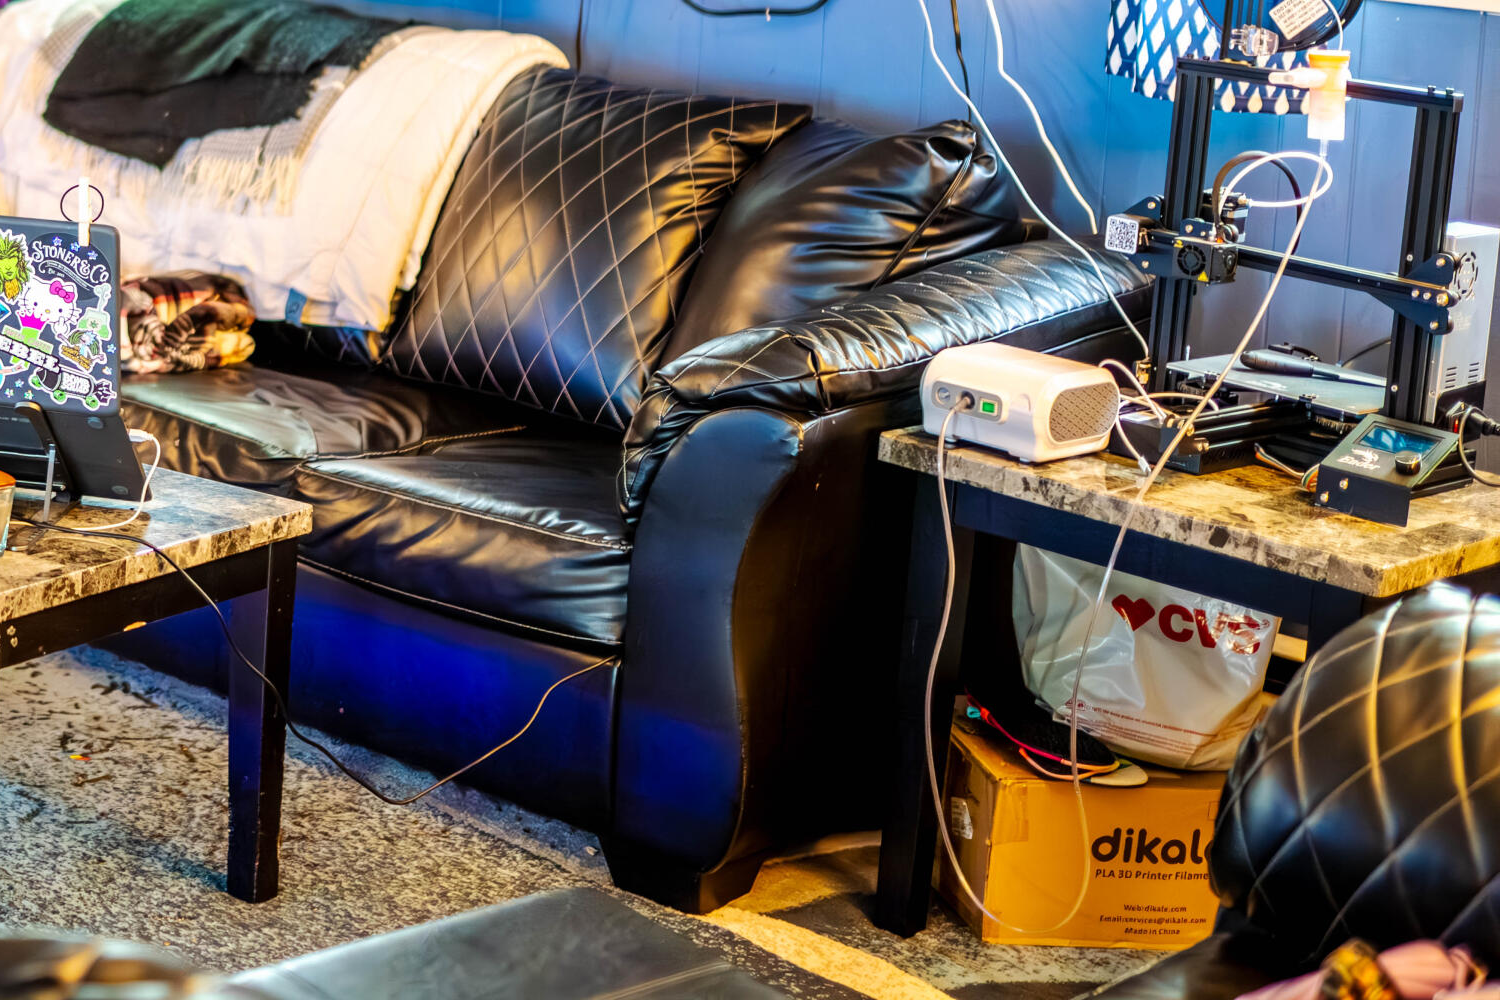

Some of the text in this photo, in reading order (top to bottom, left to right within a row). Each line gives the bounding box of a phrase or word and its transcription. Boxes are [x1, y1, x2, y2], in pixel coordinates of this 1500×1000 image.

[1158, 603, 1261, 656] CVS
[1095, 868, 1116, 880] PLA
[1118, 870, 1133, 880] 3D
[1135, 870, 1173, 881] Printer
[1124, 927, 1181, 936] Made in China
